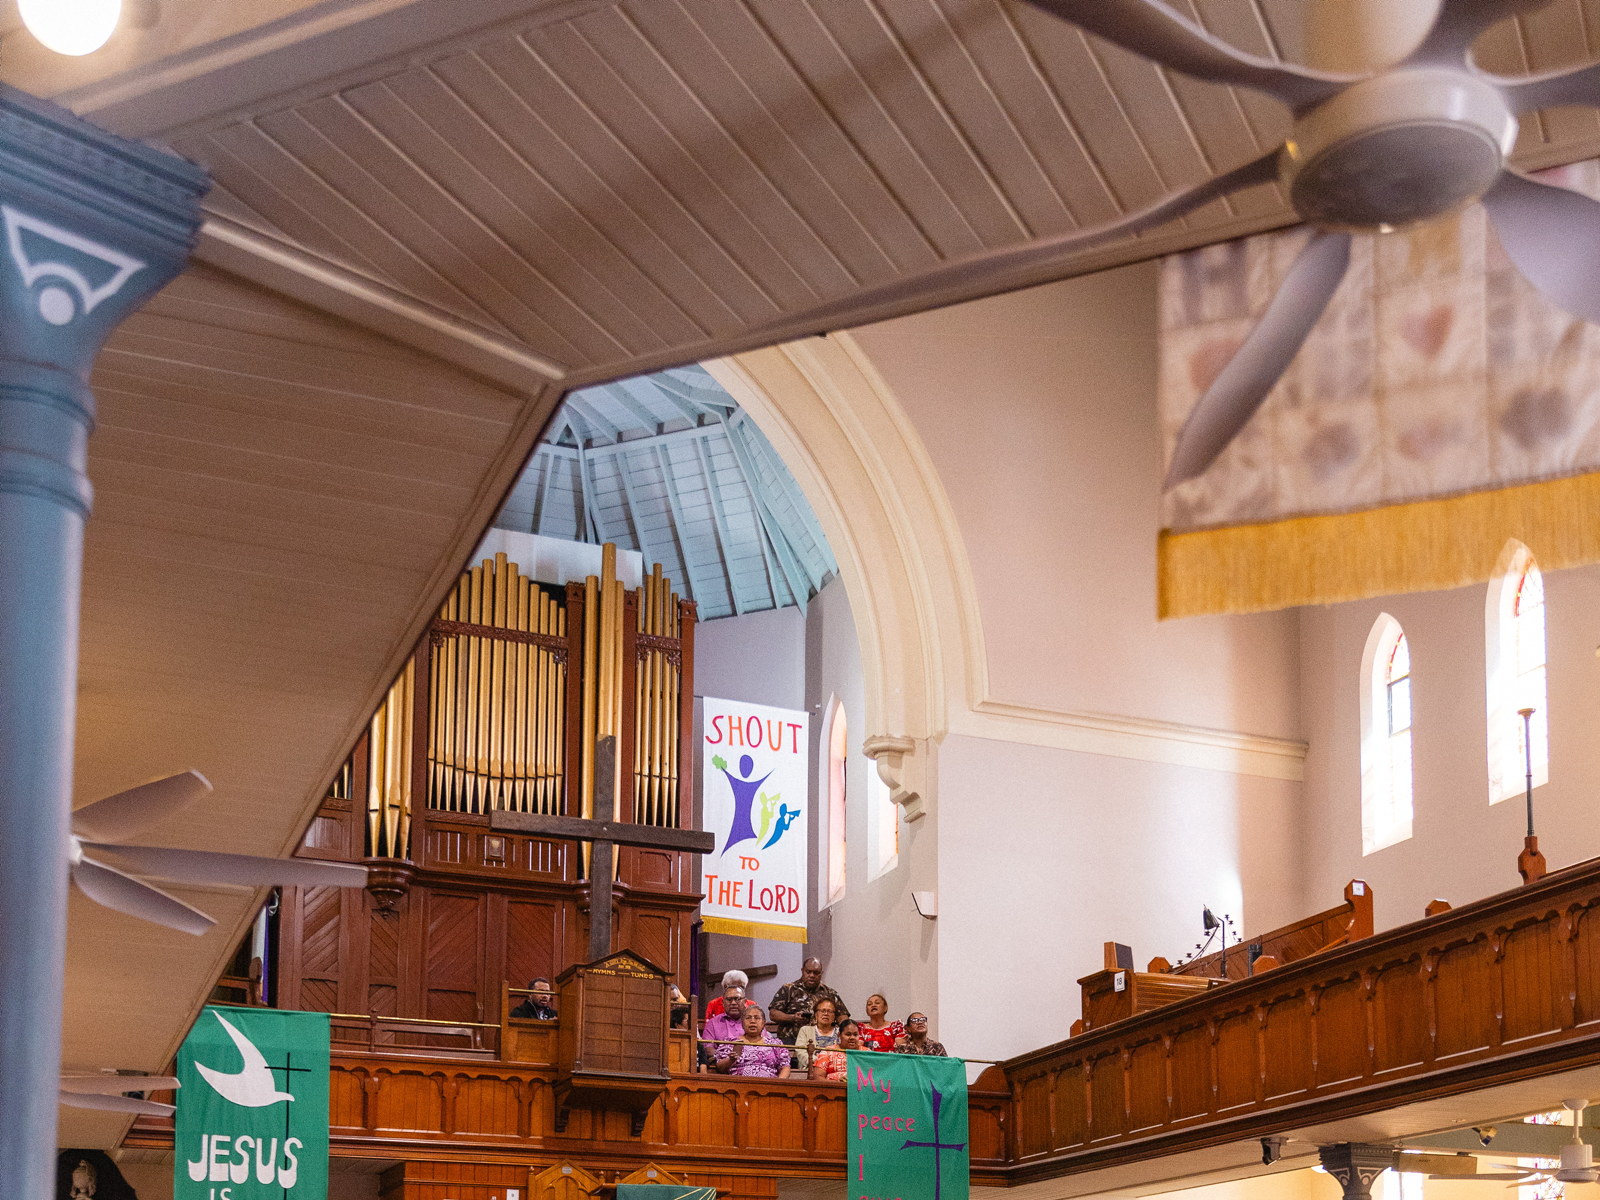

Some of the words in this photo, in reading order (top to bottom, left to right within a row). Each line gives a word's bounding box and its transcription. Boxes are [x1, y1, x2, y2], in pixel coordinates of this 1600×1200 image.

[705, 715, 802, 754] SHOUT
[739, 856, 760, 871] TO
[705, 874, 743, 908] THE
[748, 879, 799, 913] LORD
[856, 1066, 892, 1103] My
[858, 1114, 915, 1140] peace
[187, 1134, 303, 1189] JESUS
[858, 1154, 864, 1181] I
